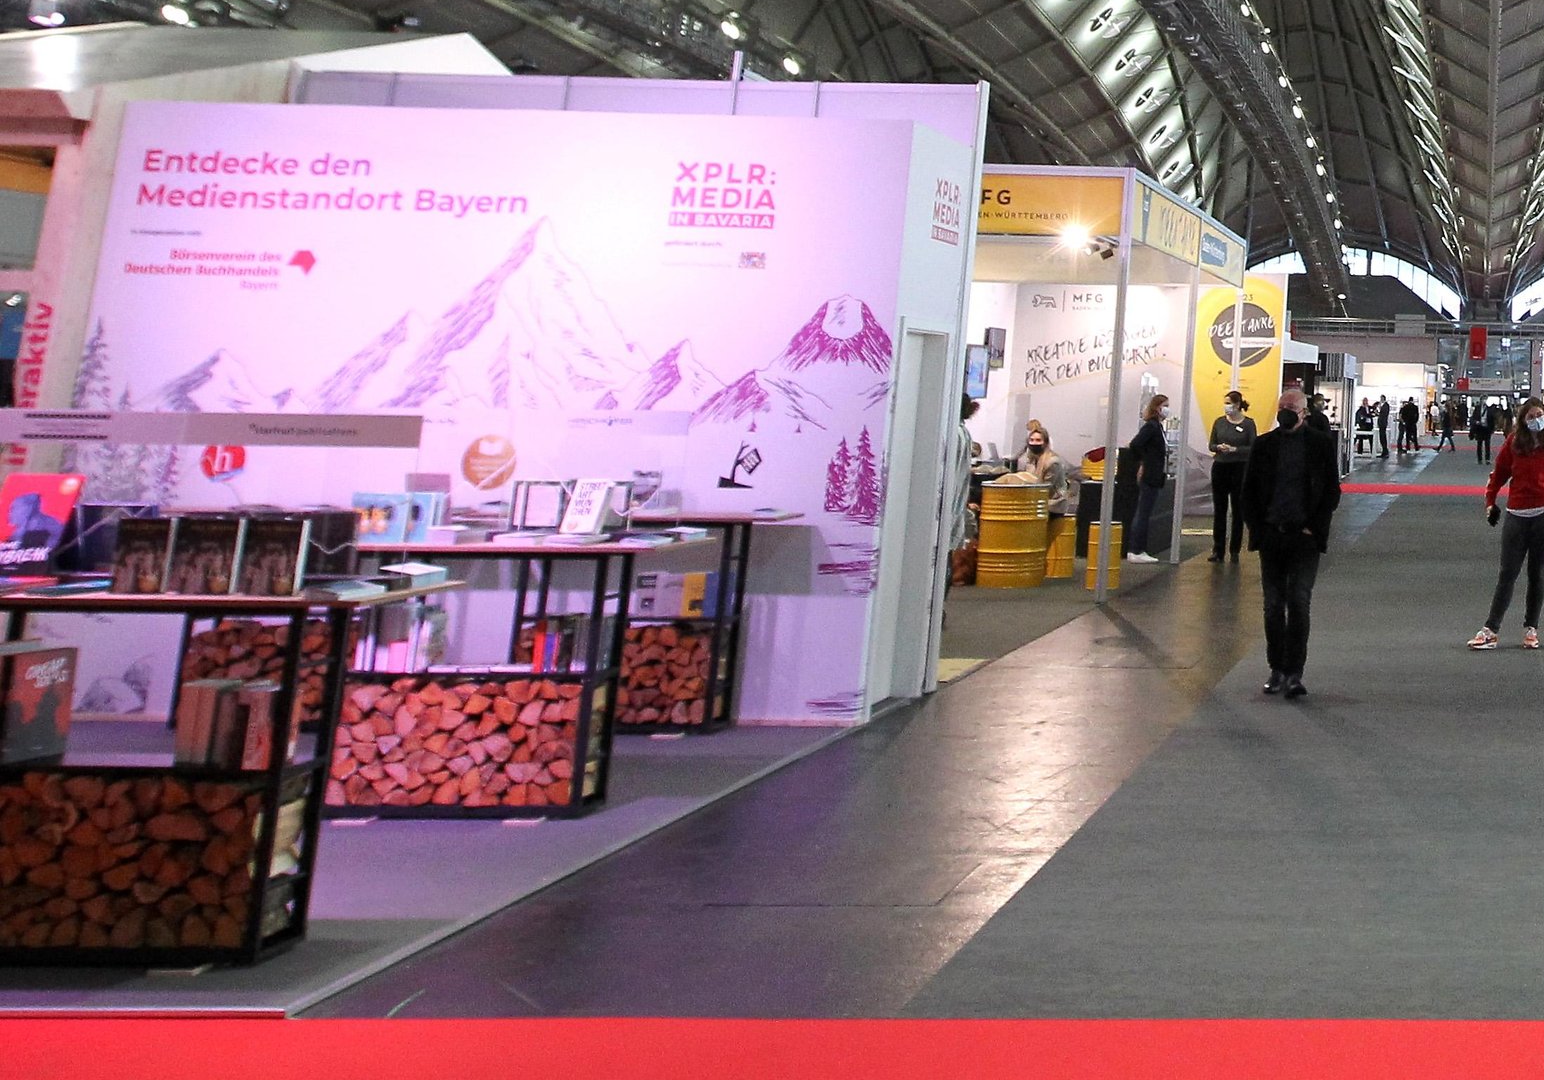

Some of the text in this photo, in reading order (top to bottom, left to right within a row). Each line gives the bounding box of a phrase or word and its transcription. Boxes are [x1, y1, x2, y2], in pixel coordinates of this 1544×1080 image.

[143, 149, 371, 177] Entdecke den
[676, 161, 776, 185] XPLR:
[136, 183, 528, 218] Medienstandort Bayern
[671, 186, 776, 210] MEDIA
[671, 212, 773, 228] IN BAVARIA
[1072, 293, 1104, 303] MFG
